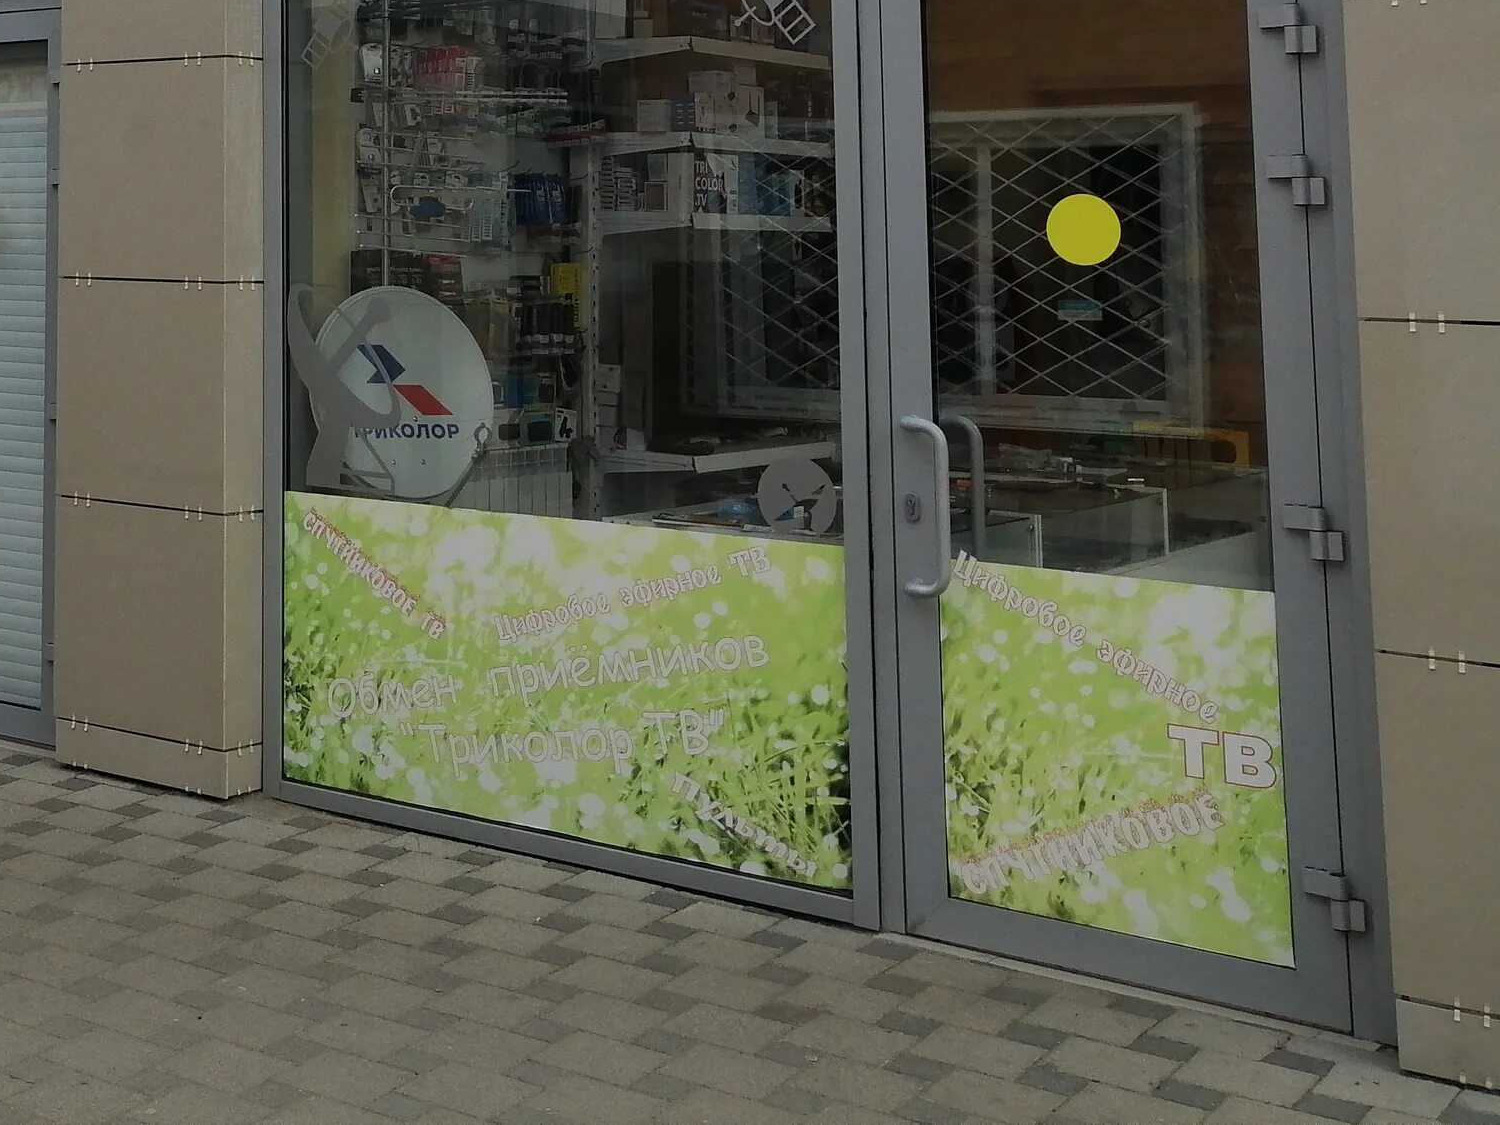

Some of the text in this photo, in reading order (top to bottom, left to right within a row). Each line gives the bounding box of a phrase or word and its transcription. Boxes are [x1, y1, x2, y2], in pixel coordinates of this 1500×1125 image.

[354, 423, 460, 439] РИКОЛОР
[494, 545, 772, 643] Цифровое эфирное ТВ
[327, 634, 770, 718] Обмен приёмников
[952, 549, 1219, 725] Цифровое эфирное
[1167, 722, 1277, 789] ТВ
